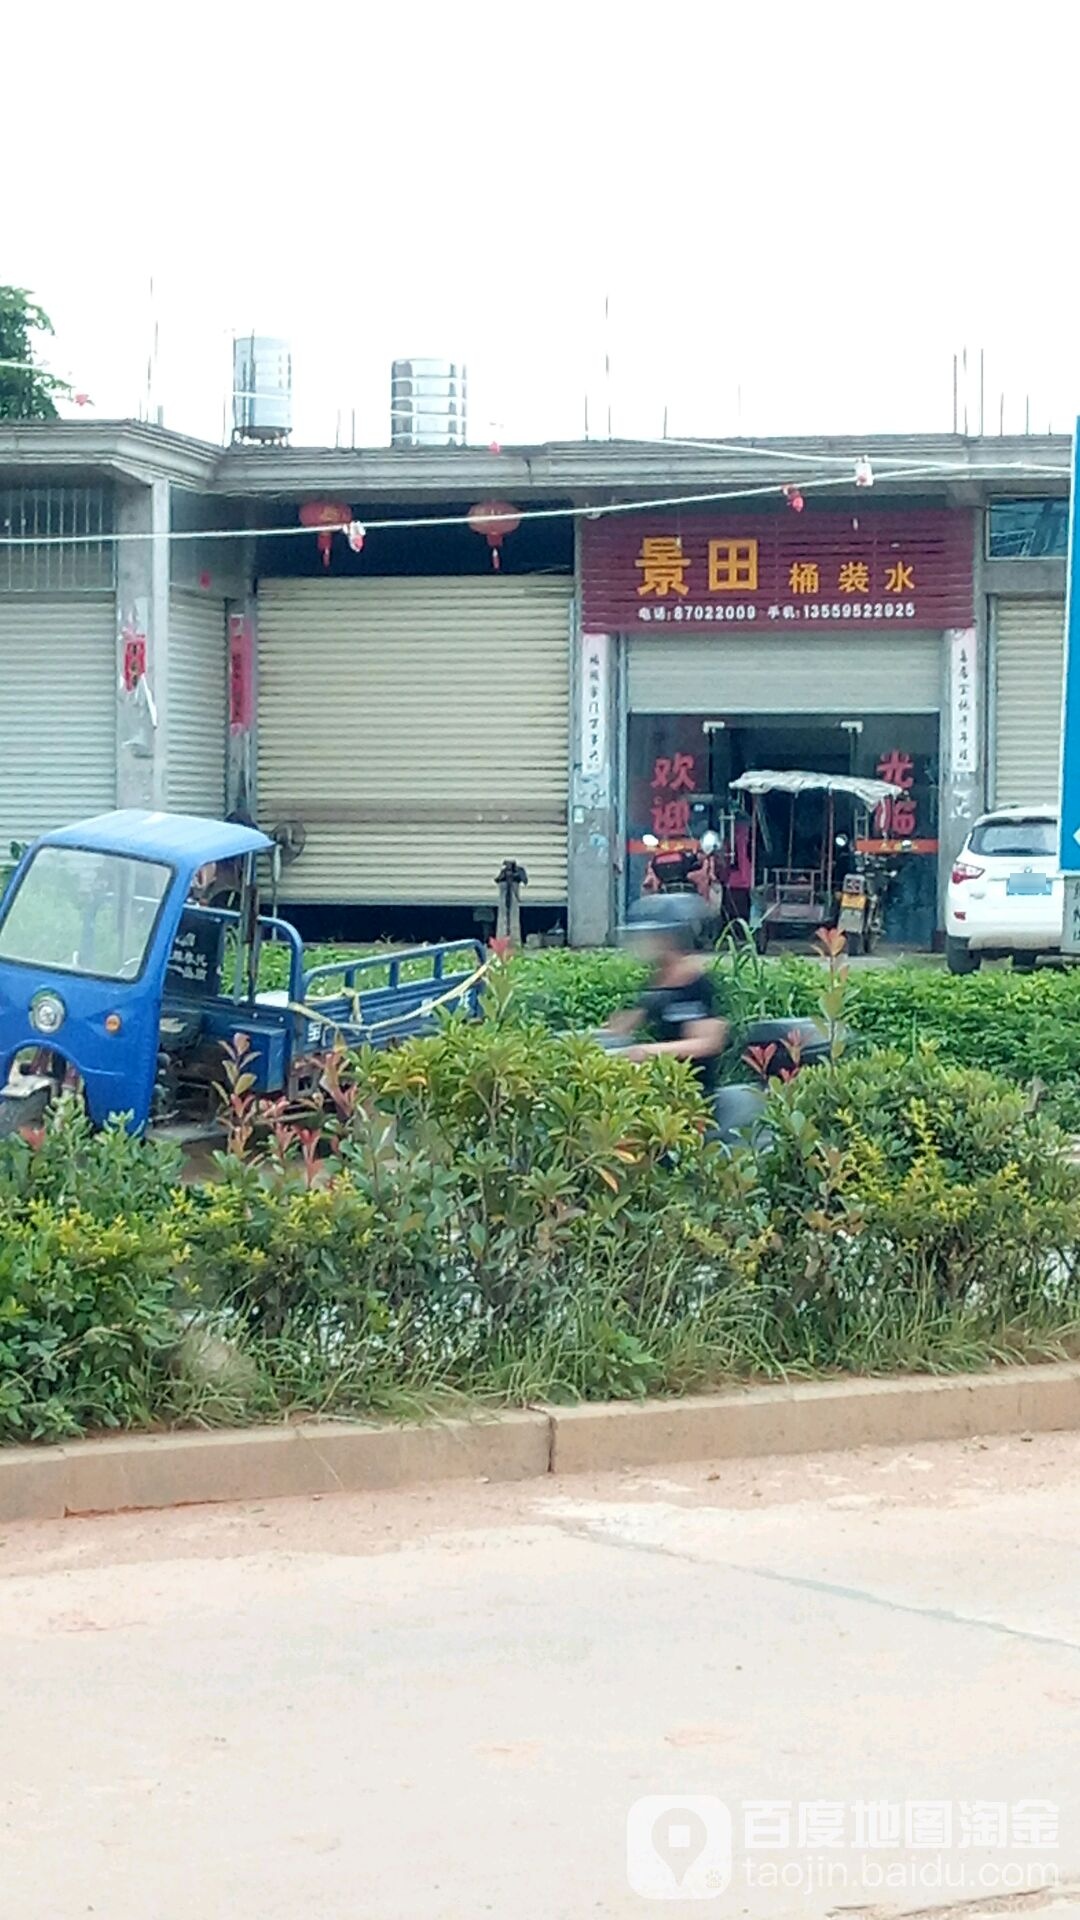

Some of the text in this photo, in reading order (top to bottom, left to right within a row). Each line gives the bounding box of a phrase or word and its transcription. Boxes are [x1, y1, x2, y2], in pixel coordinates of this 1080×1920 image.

[635, 537, 916, 597] 景田 桶装水
[650, 752, 697, 837] 欢迎
[875, 749, 916, 835] 光临
